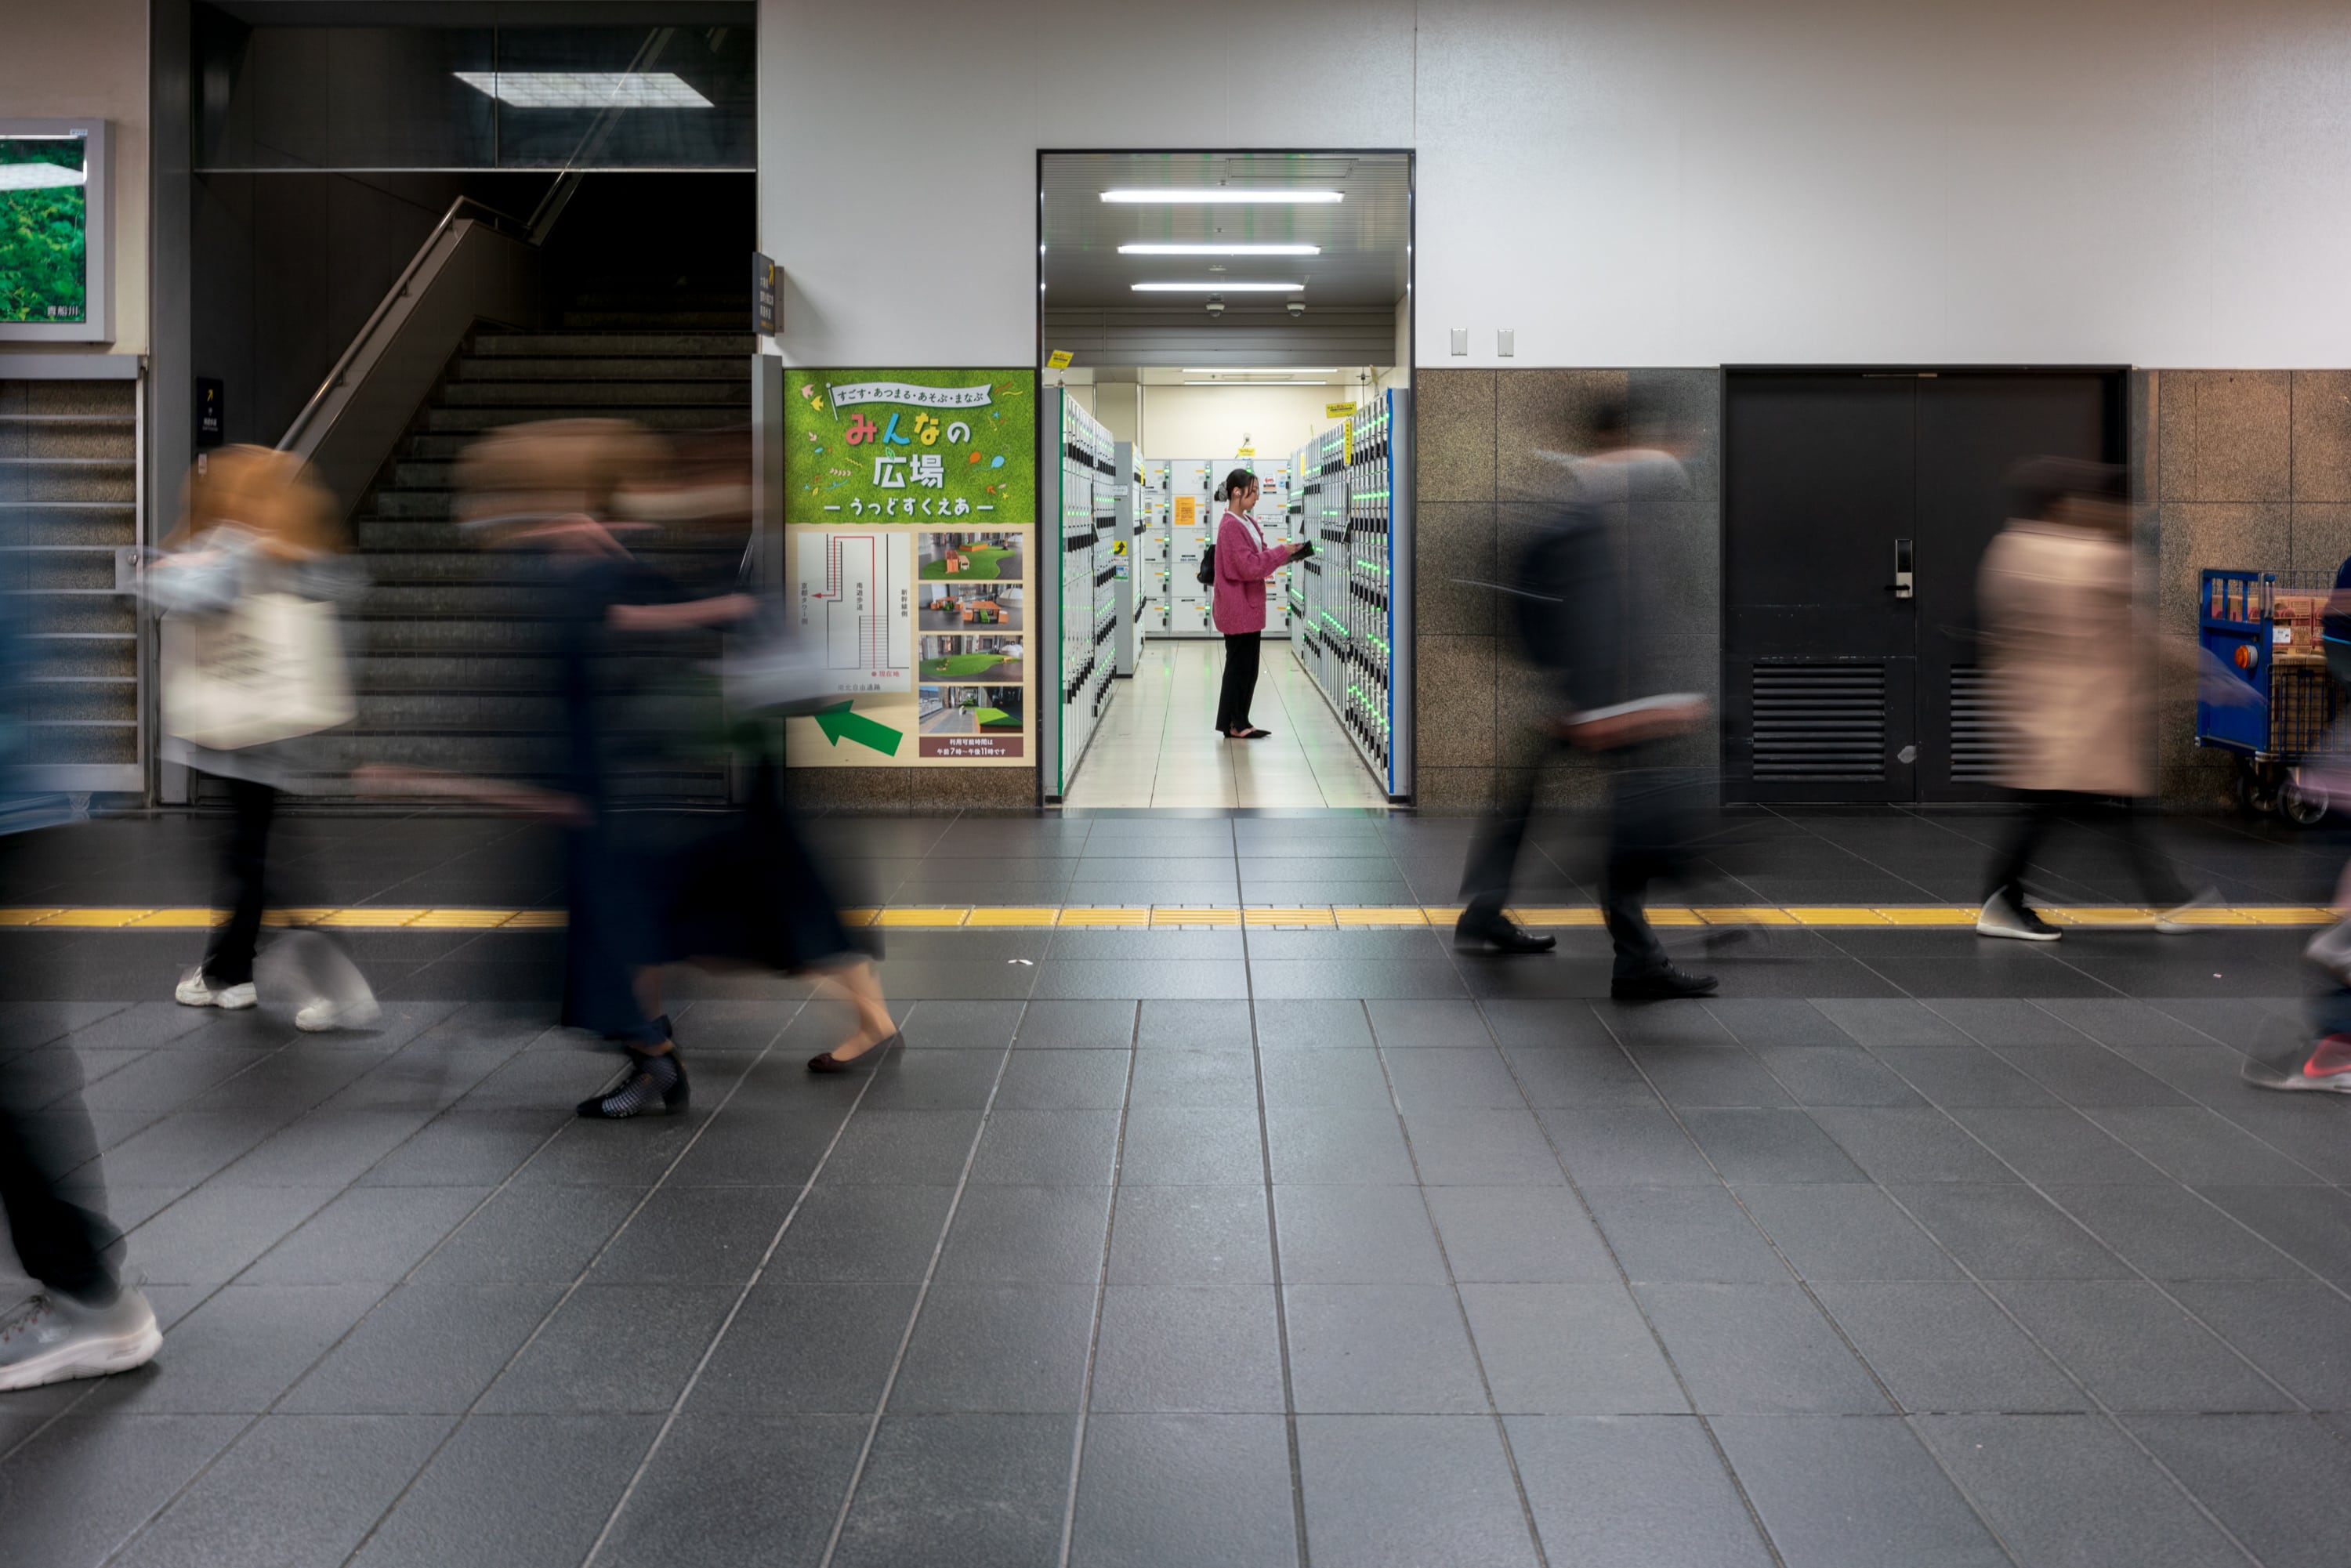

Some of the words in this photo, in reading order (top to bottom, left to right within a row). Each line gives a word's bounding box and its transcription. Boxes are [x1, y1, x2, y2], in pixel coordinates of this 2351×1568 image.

[837, 387, 984, 404] すごす・あつまる・あそぶ・まなぶ
[846, 412, 971, 446] みんなの
[872, 449, 944, 489] 広場
